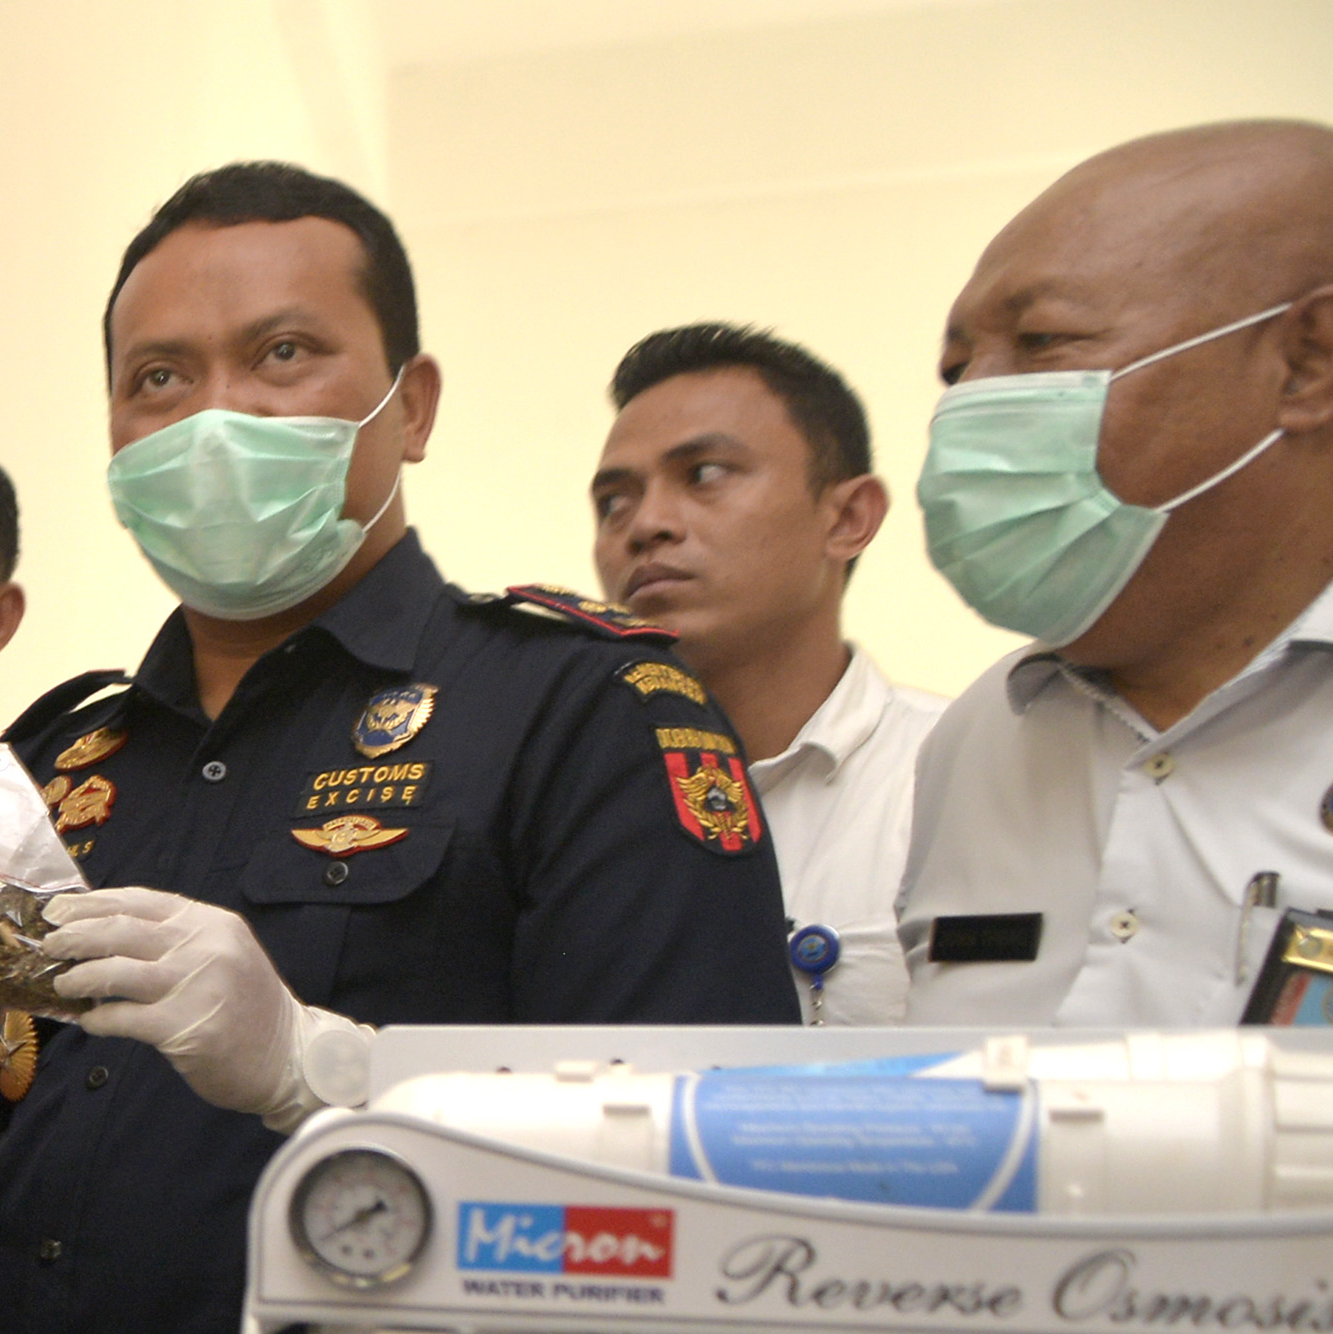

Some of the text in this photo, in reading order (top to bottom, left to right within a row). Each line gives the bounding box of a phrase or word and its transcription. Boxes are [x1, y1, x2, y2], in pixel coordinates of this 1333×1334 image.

[313, 763, 425, 791] CUSTOMS
[306, 785, 417, 809] EXCISE
[465, 1207, 666, 1265] Micron
[713, 1232, 1024, 1318] Reverse
[463, 1278, 665, 1303] WATER PURIFIER
